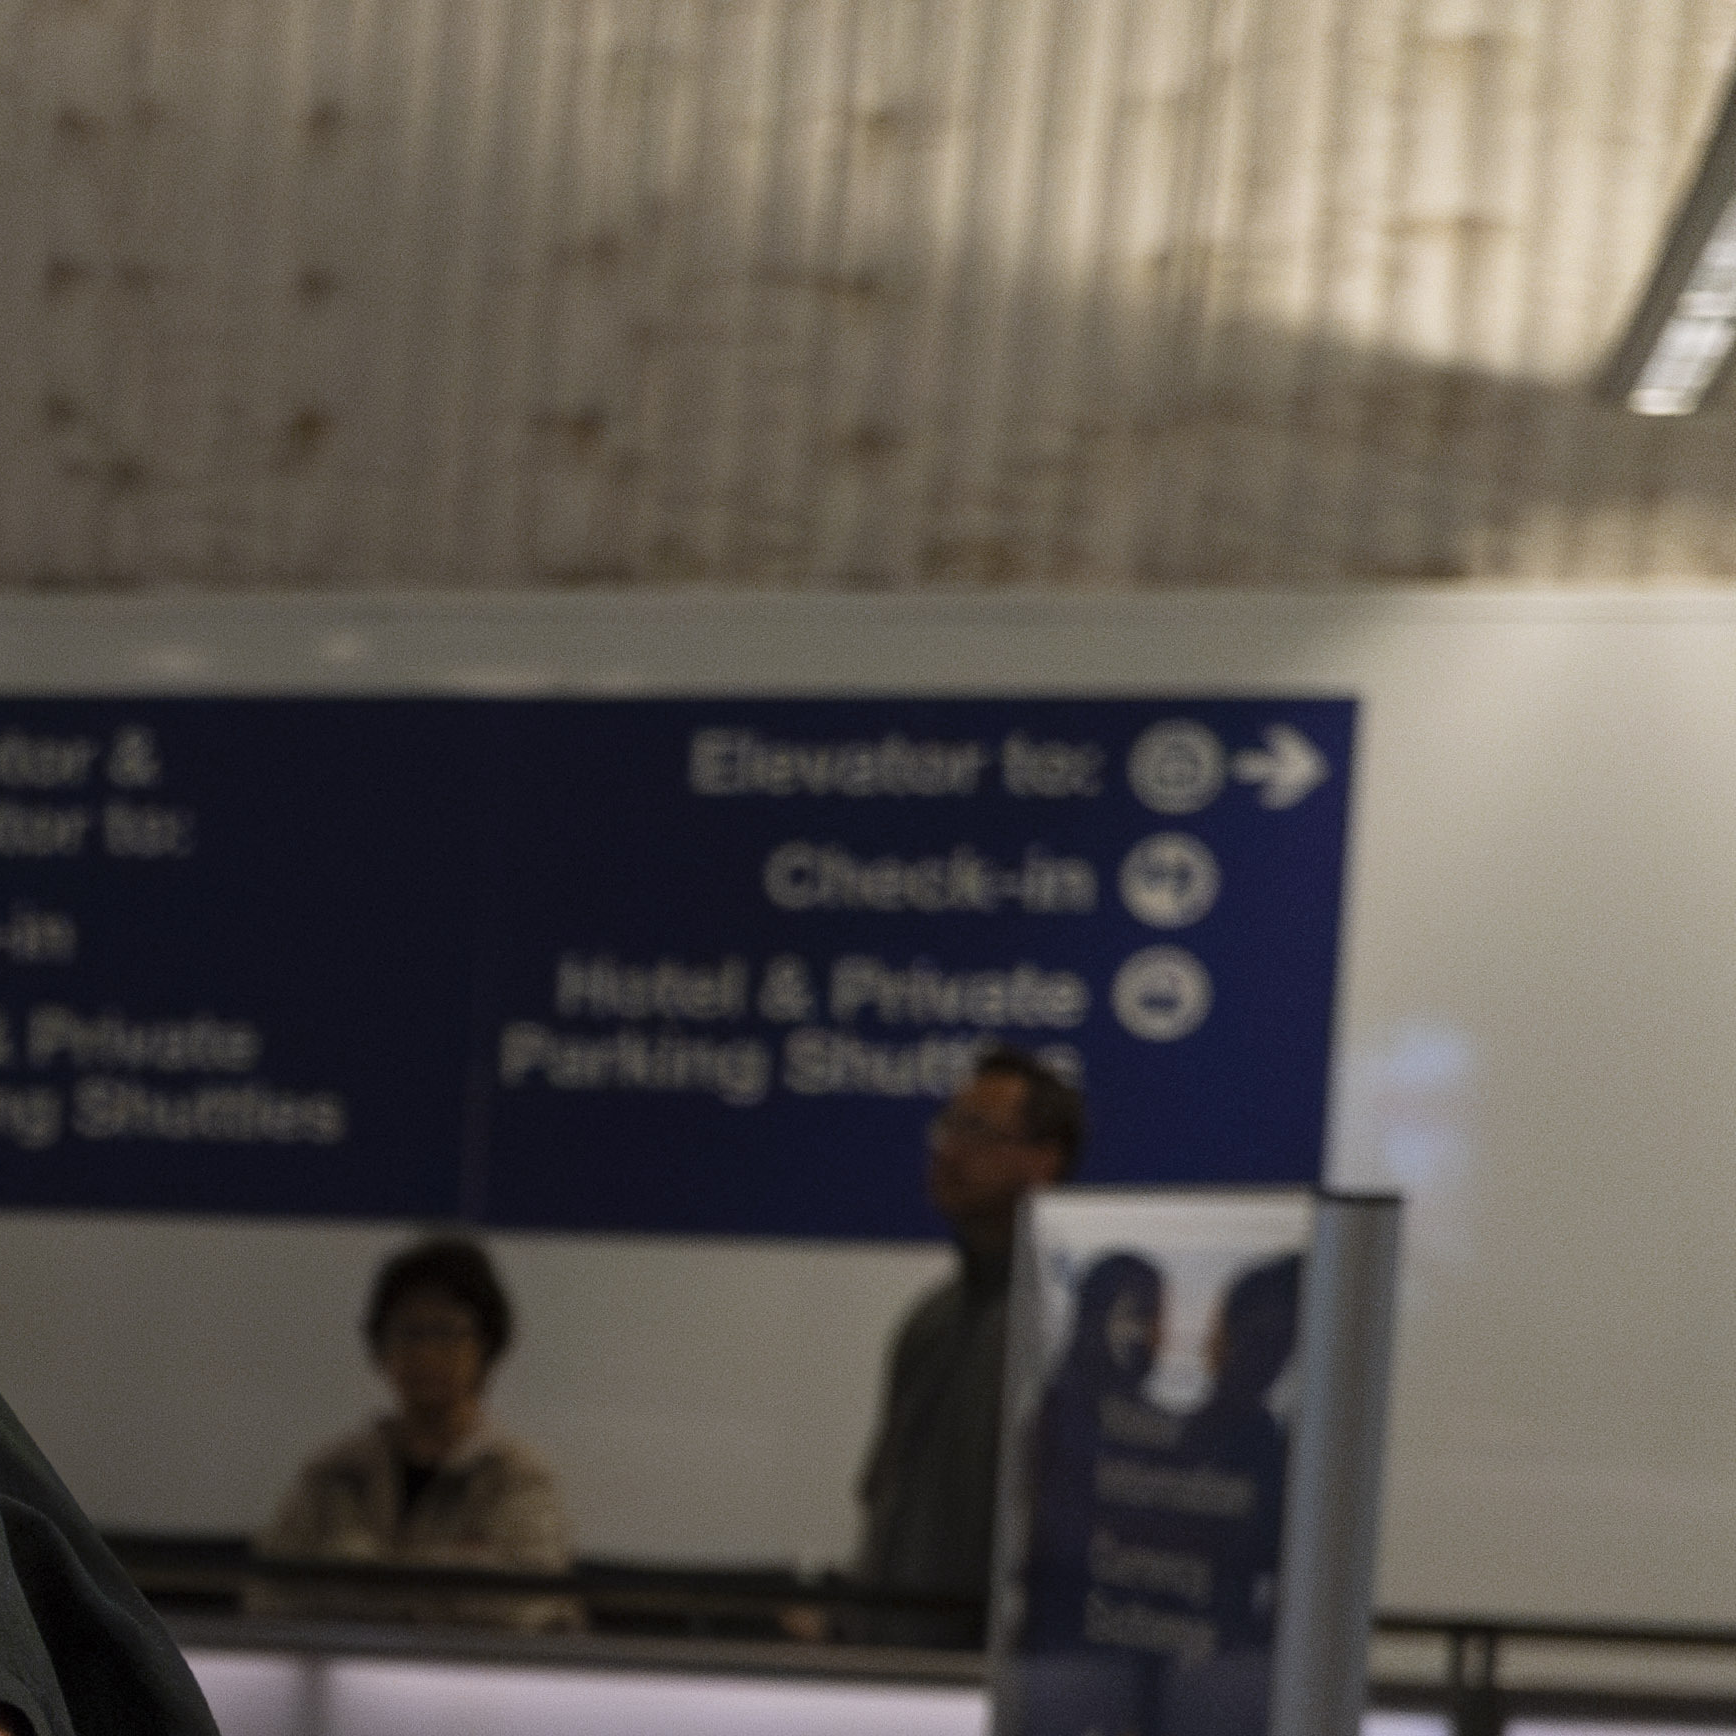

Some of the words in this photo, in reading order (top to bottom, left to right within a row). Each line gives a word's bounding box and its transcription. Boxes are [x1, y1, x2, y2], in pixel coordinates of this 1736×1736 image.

[108, 725, 162, 788] &
[688, 728, 982, 796] Elevator
[1003, 730, 1102, 797] to:
[763, 840, 1097, 912] Check-in
[557, 953, 748, 1021] Hotel
[758, 953, 814, 1024] &
[831, 955, 1089, 1030] Private
[29, 1003, 261, 1072] Private
[500, 1022, 770, 1108] Parking
[74, 1076, 346, 1145] Shuttles
